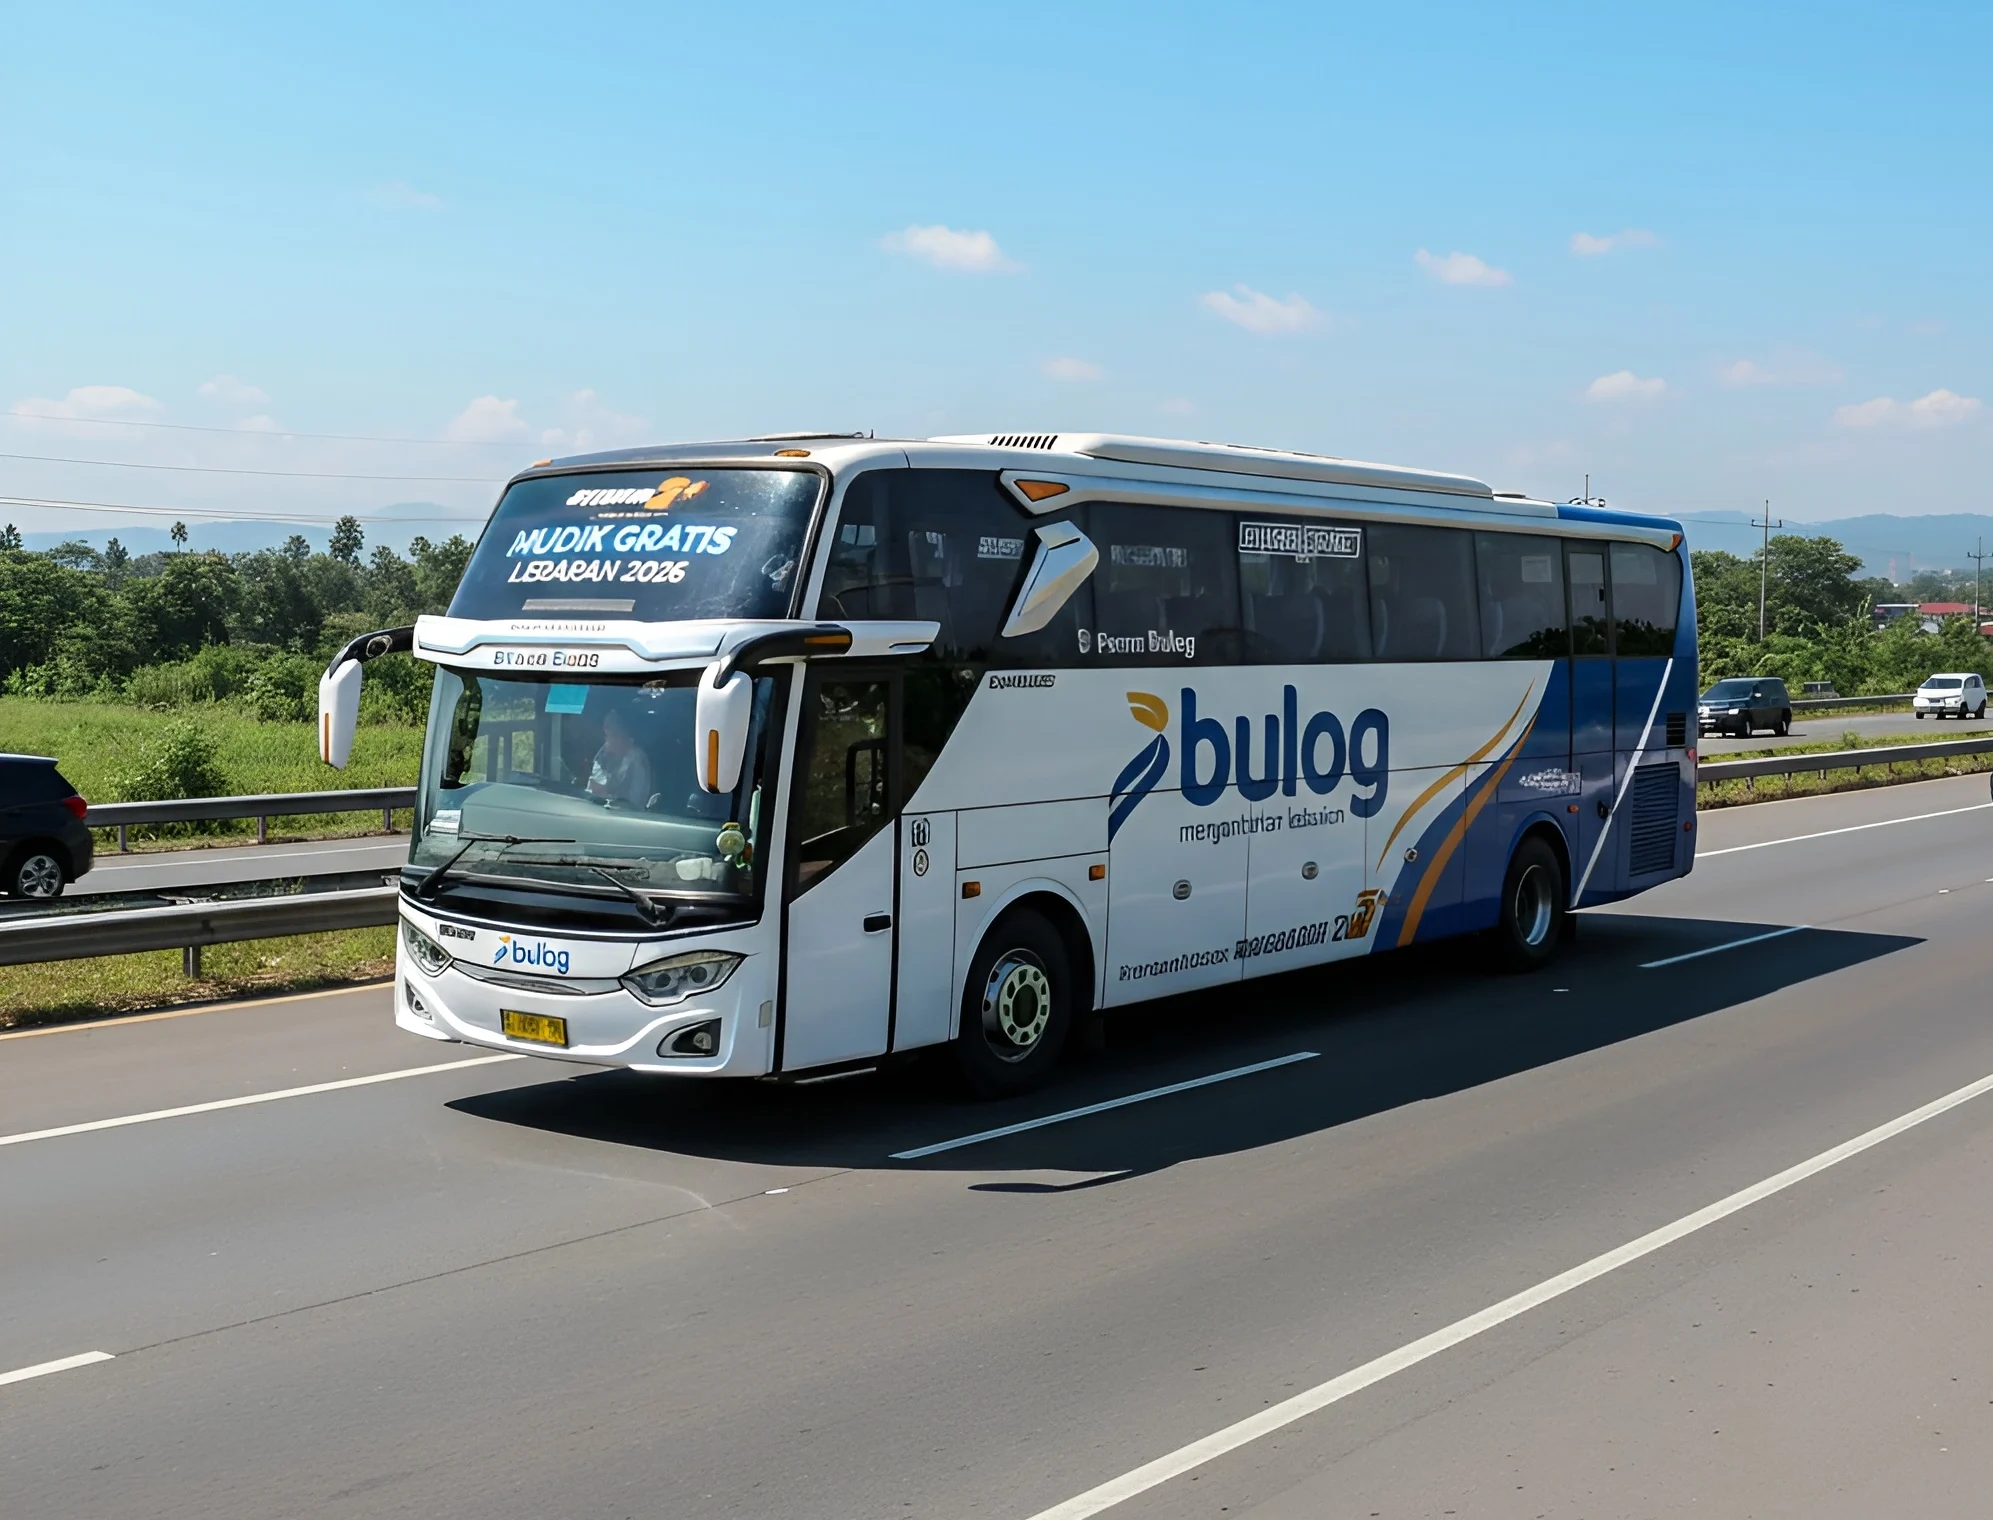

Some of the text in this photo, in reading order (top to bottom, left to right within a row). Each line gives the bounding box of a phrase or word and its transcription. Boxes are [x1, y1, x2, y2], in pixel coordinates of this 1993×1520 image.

[506, 524, 738, 557] MUDIK GRATIS
[620, 560, 690, 583] 2026
[1181, 684, 1389, 818] bulog
